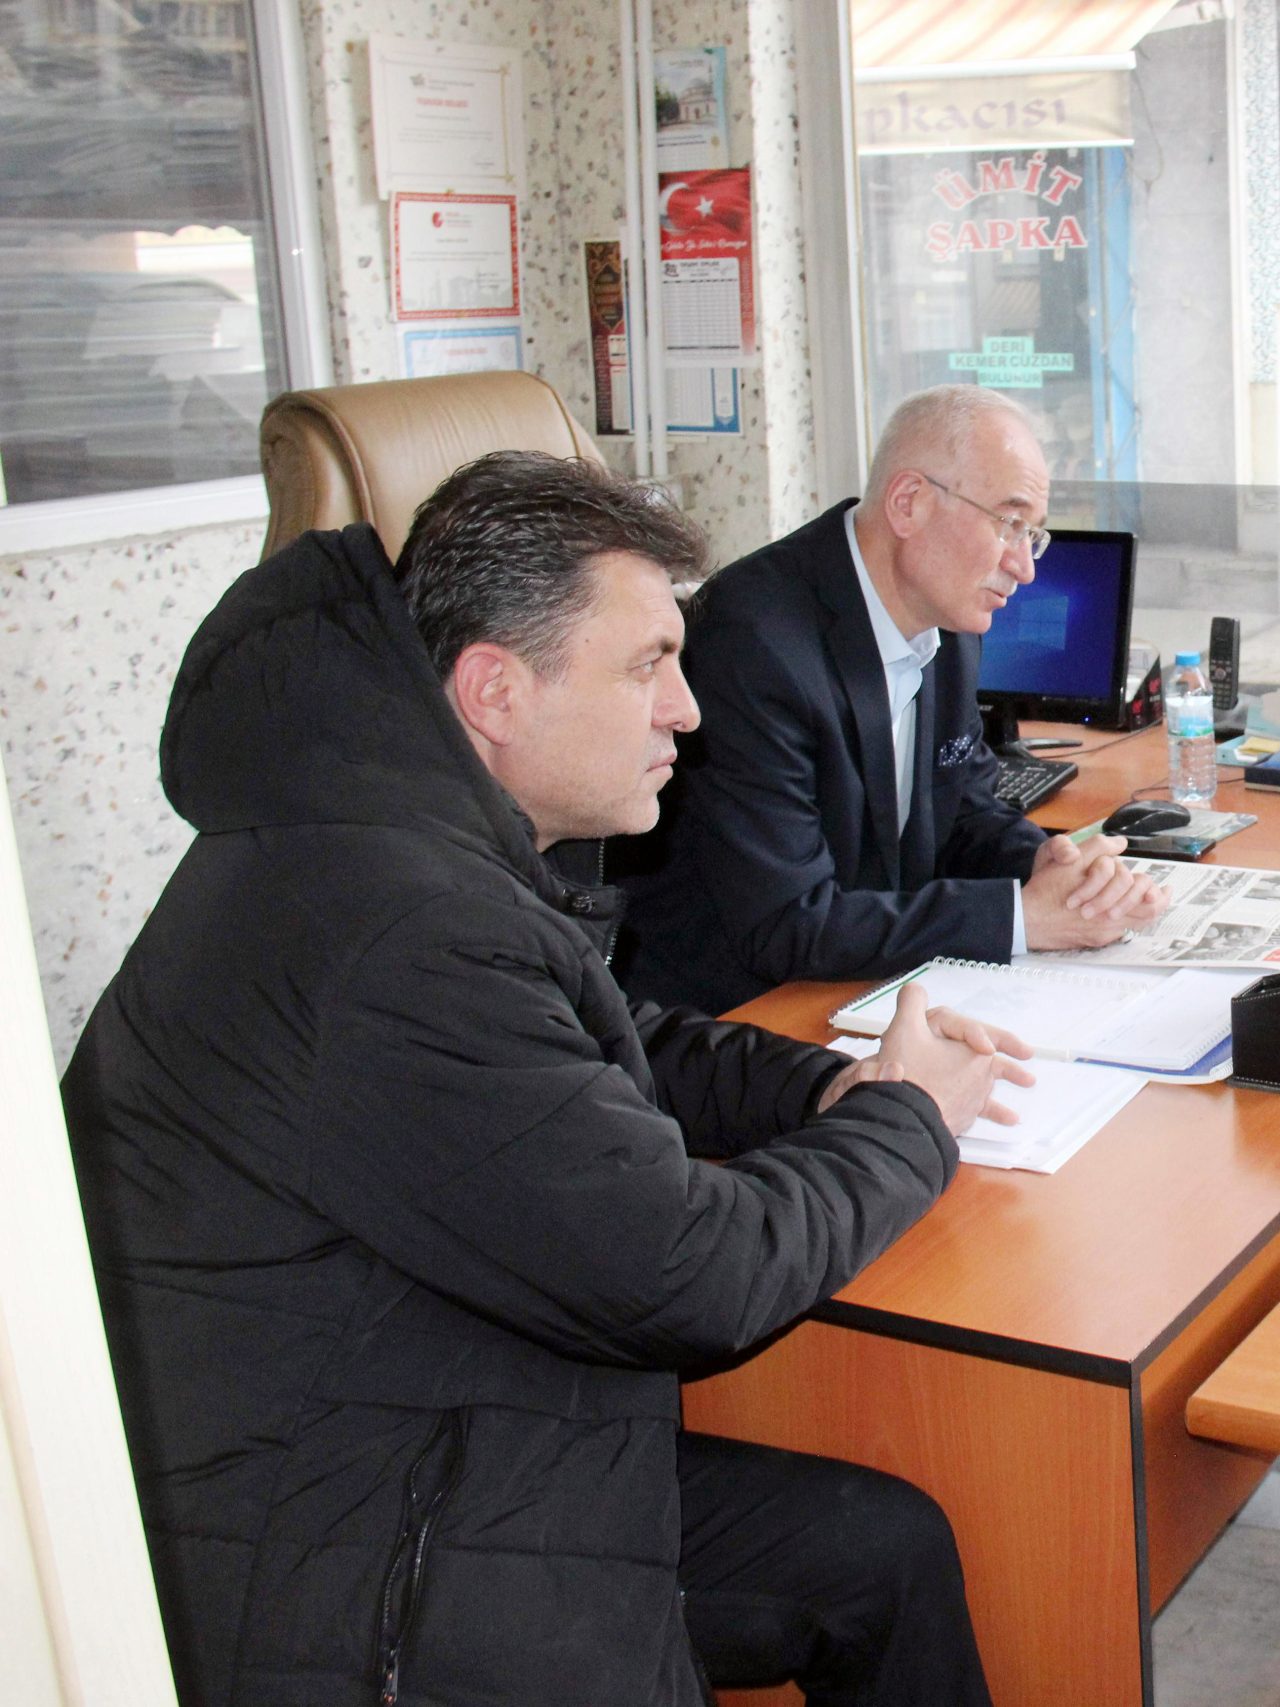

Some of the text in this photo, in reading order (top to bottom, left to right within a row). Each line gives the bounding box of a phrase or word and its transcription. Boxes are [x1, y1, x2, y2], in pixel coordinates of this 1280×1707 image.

[933, 152, 1082, 209] ÜMİT
[927, 216, 1087, 261] ŞAPKA
[955, 354, 1007, 368] KEMER
[979, 371, 1042, 384] BULUNUR
